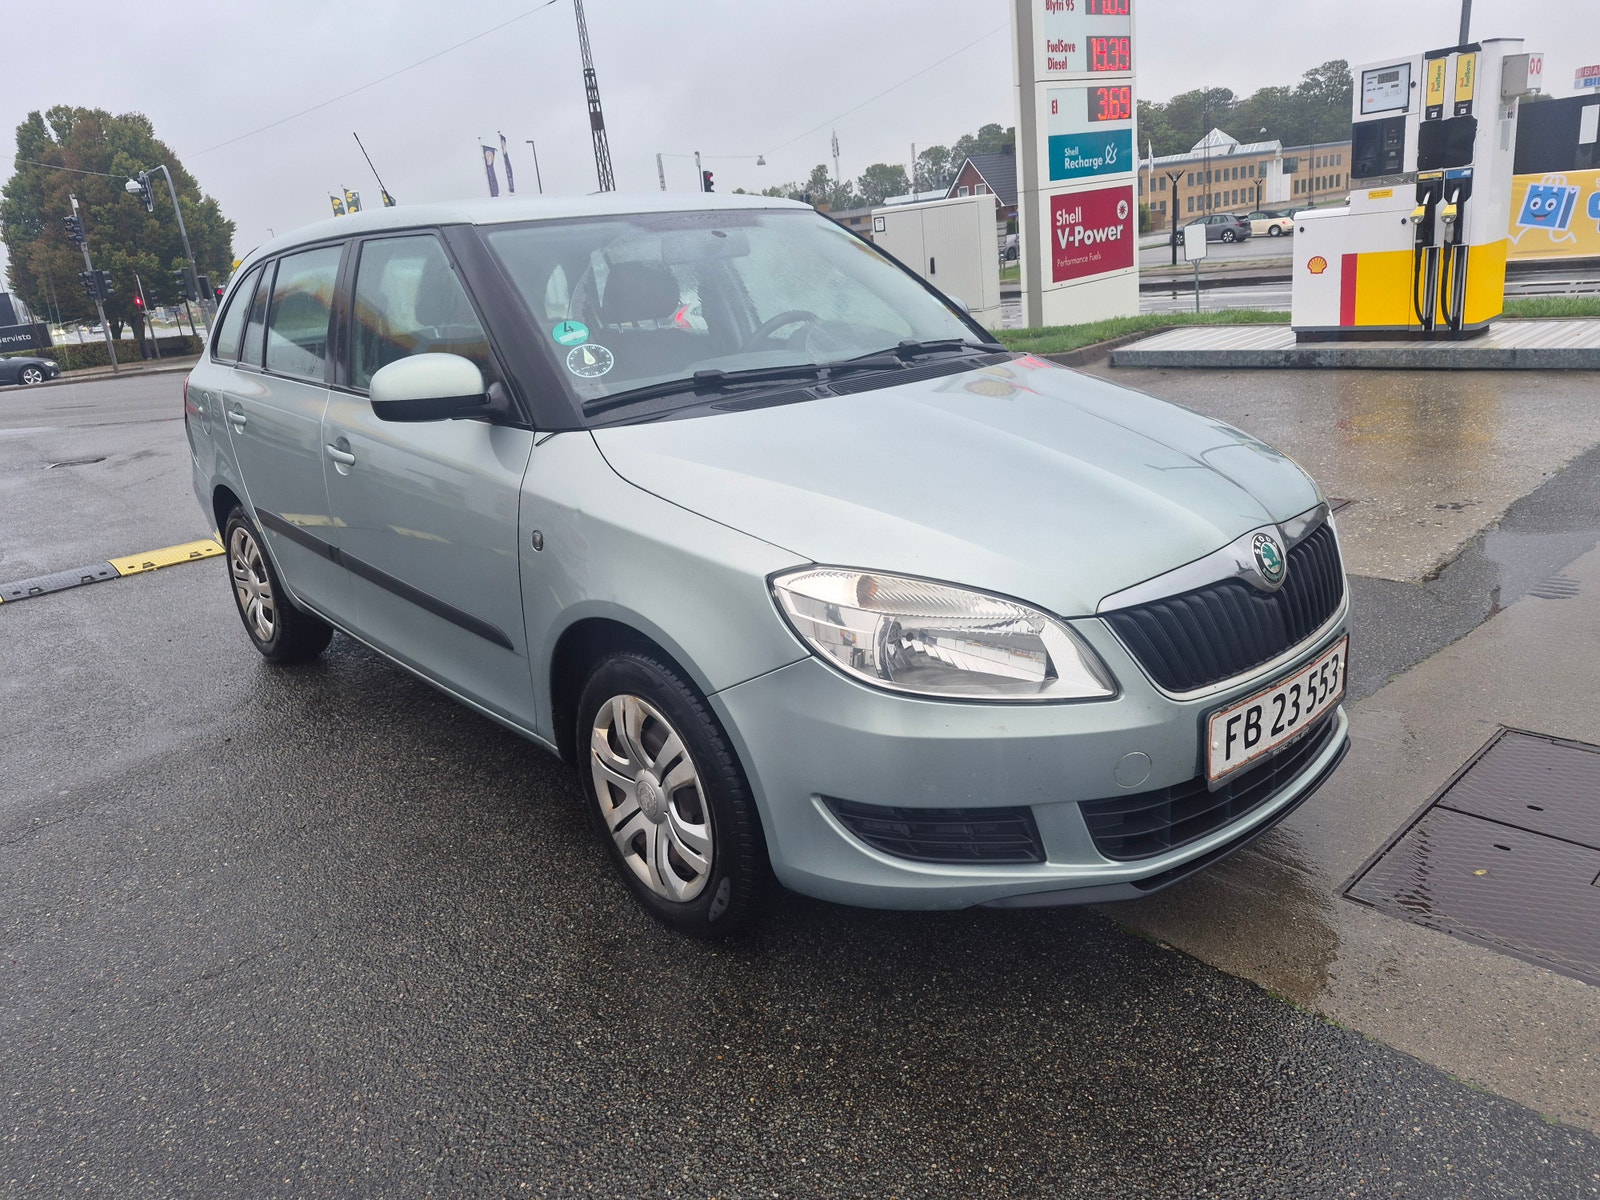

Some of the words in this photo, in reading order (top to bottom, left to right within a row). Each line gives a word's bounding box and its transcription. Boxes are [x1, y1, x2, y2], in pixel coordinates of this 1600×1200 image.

[1045, 0, 1064, 15] Blyfri
[1065, 0, 1075, 11] 95
[1047, 39, 1076, 53] FuelSave
[1047, 56, 1068, 70] Diesel
[1051, 98, 1058, 115] El
[1064, 146, 1079, 157] Shell
[1064, 155, 1103, 170] Recharge
[1056, 206, 1082, 226] Shell
[1056, 224, 1124, 250] V-Power
[1057, 254, 1088, 268] Performance
[1089, 250, 1102, 261] Fuels
[1225, 704, 1263, 761] FB
[1270, 683, 1301, 738] 23
[1305, 653, 1339, 714] 553
